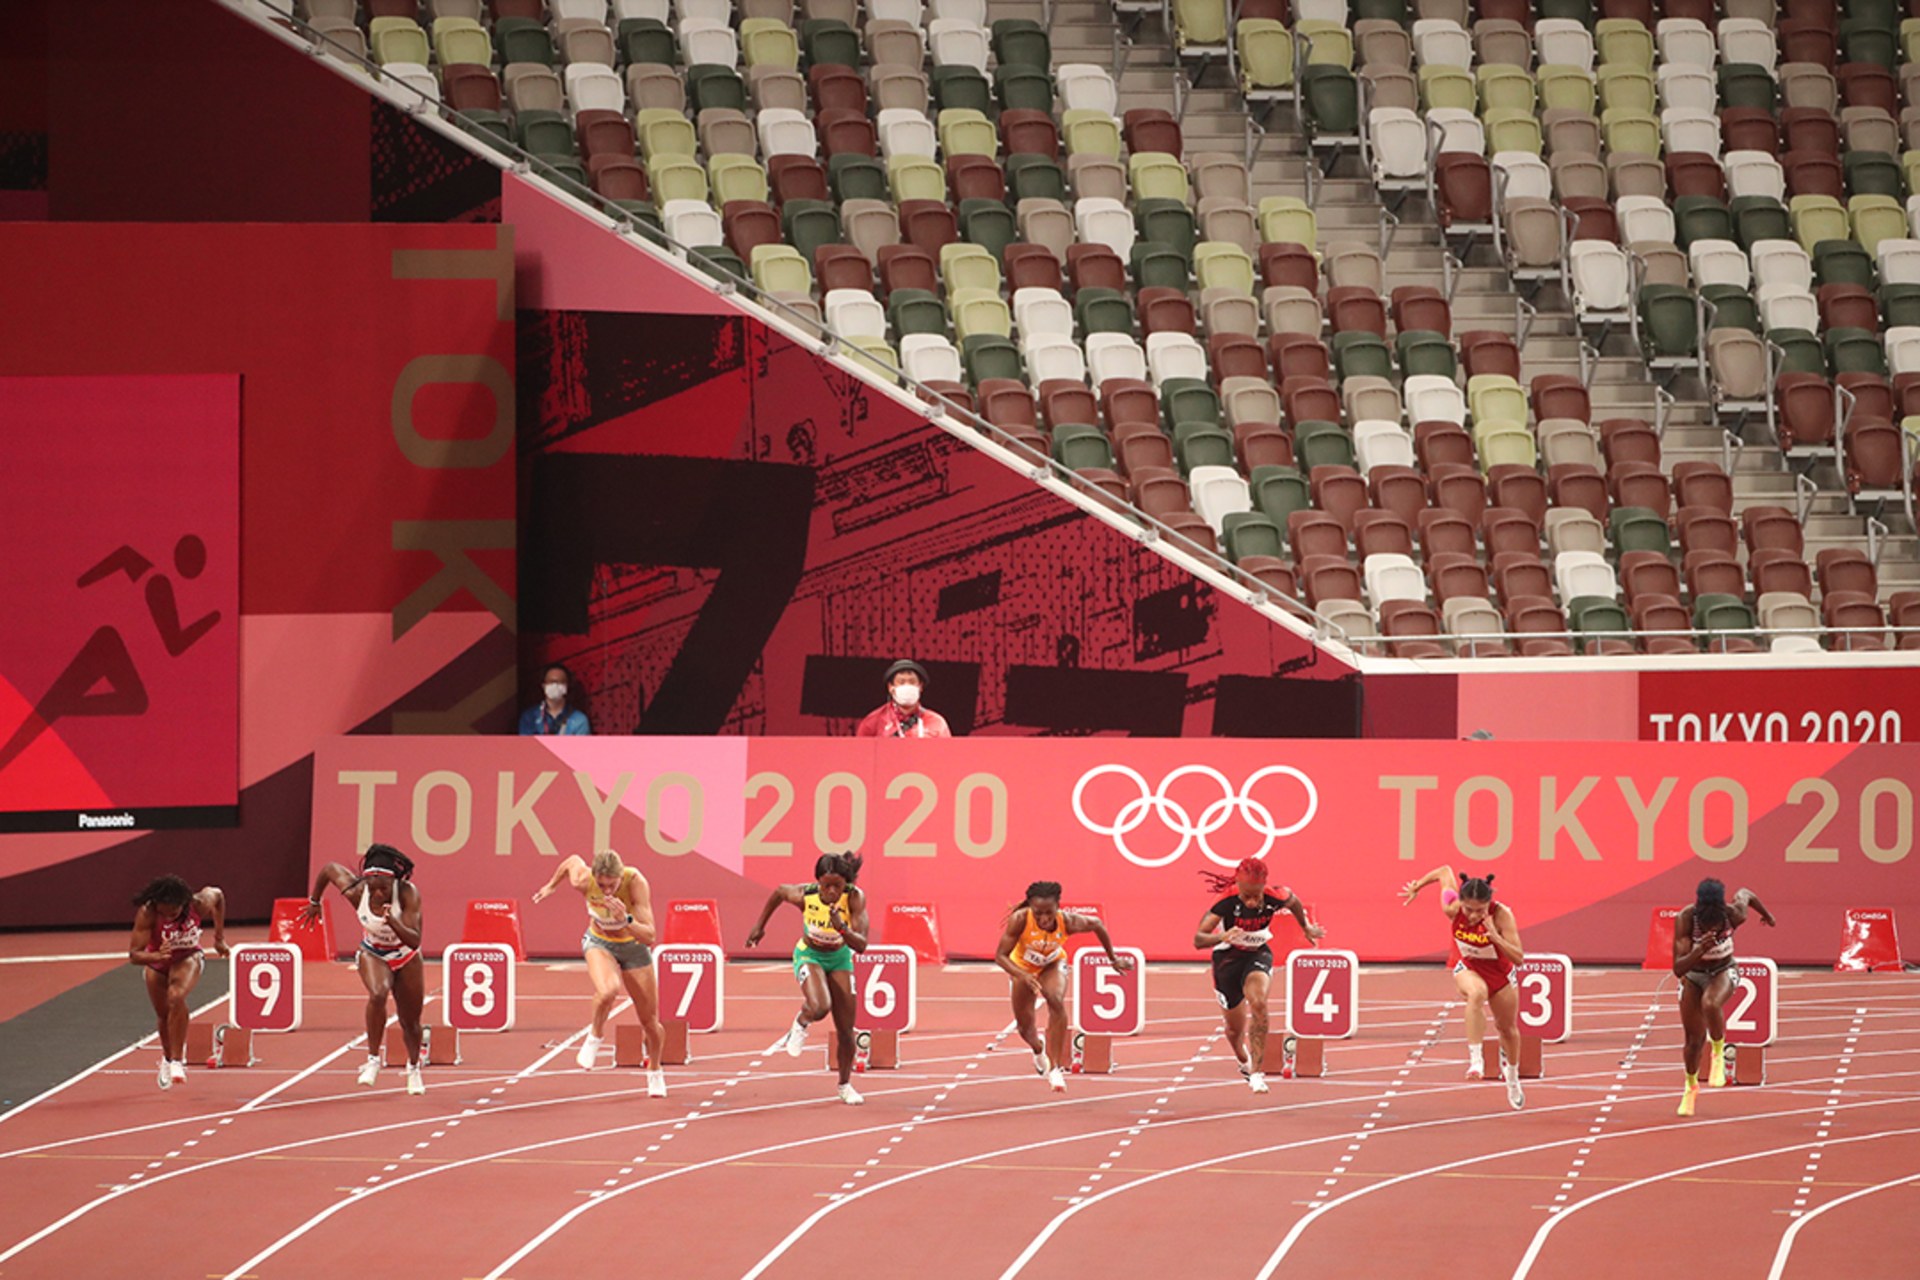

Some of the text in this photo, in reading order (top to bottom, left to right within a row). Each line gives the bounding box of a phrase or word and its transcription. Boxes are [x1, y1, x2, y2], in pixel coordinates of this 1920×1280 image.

[78, 812, 136, 828] Panasonic
[338, 771, 1008, 858] TOKYO 2020
[1378, 775, 1914, 864] TOKYO 20
[240, 952, 291, 963] TOKYO 2020
[453, 952, 505, 962] TOKYO 2020
[662, 953, 713, 963] TOKYO 2020
[855, 954, 906, 963] TOKYO 2020
[1296, 958, 1348, 968] TOKYO 2020
[1455, 929, 1490, 944] CHINA
[249, 963, 281, 1017] 9
[462, 963, 495, 1016] 8
[671, 963, 704, 1017] 7
[864, 963, 896, 1018] 6
[1092, 966, 1126, 1020] 5
[1540, 963, 1563, 973] 2020
[1745, 967, 1768, 977] 2020
[1303, 969, 1340, 1023] 4
[1519, 972, 1552, 1027] 3
[1725, 977, 1757, 1031] 2
